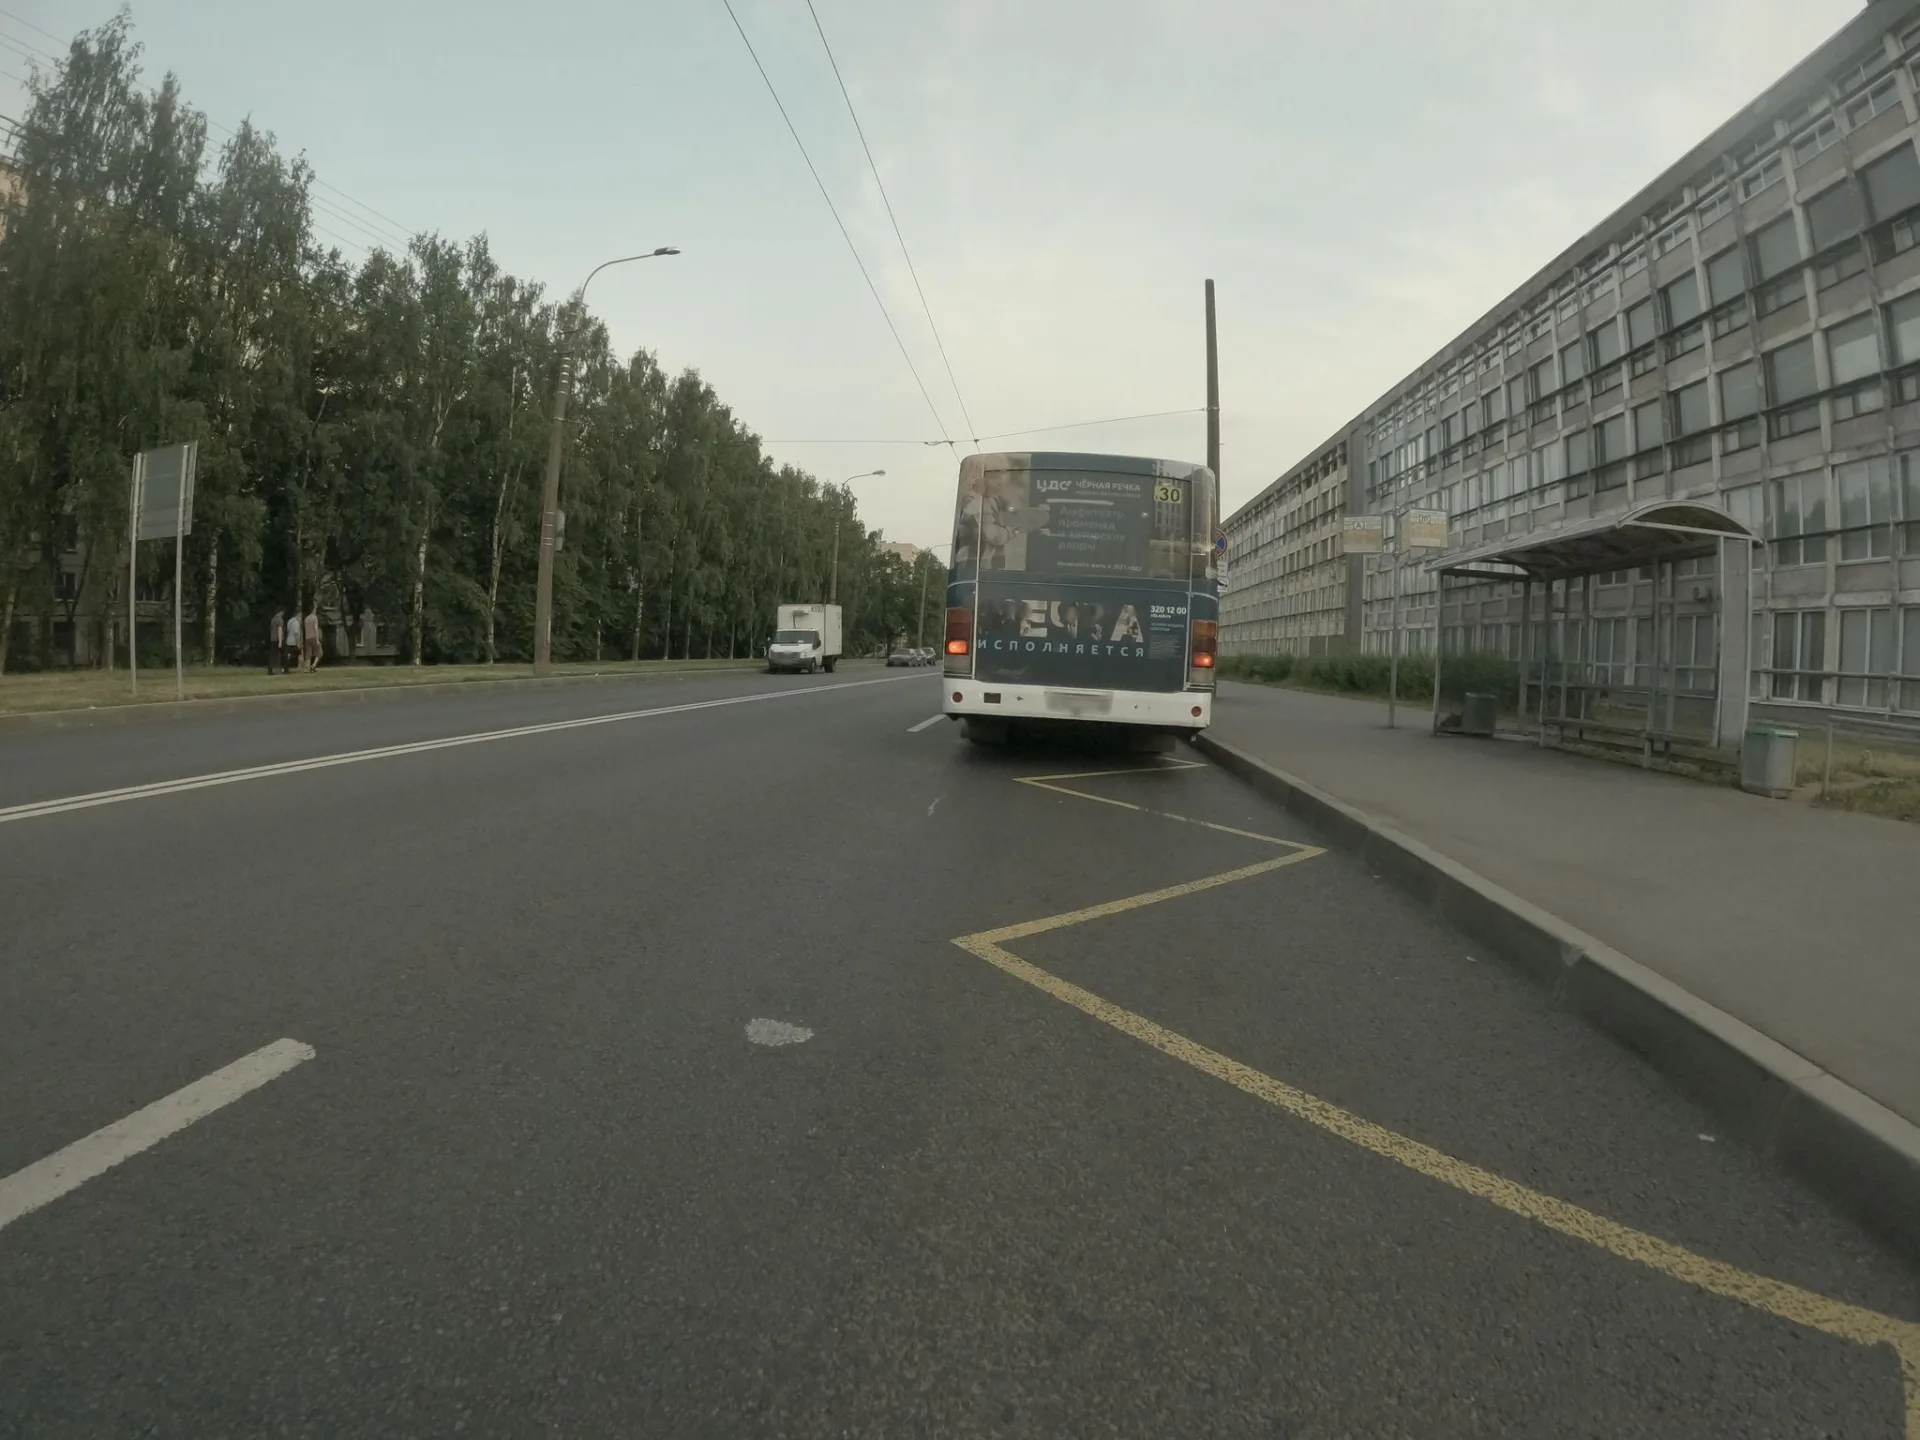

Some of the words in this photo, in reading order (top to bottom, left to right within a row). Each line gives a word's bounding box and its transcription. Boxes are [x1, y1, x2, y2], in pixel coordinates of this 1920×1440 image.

[1075, 478, 1111, 490] ЧЁРНАЯ
[1112, 482, 1141, 492] РЕЧКА
[1159, 487, 1180, 502] 30
[1150, 605, 1165, 614] 320
[1166, 606, 1175, 614] 12
[1176, 606, 1187, 615] 00
[977, 639, 1144, 658] ИСПОЛНЯЕТСЯ
